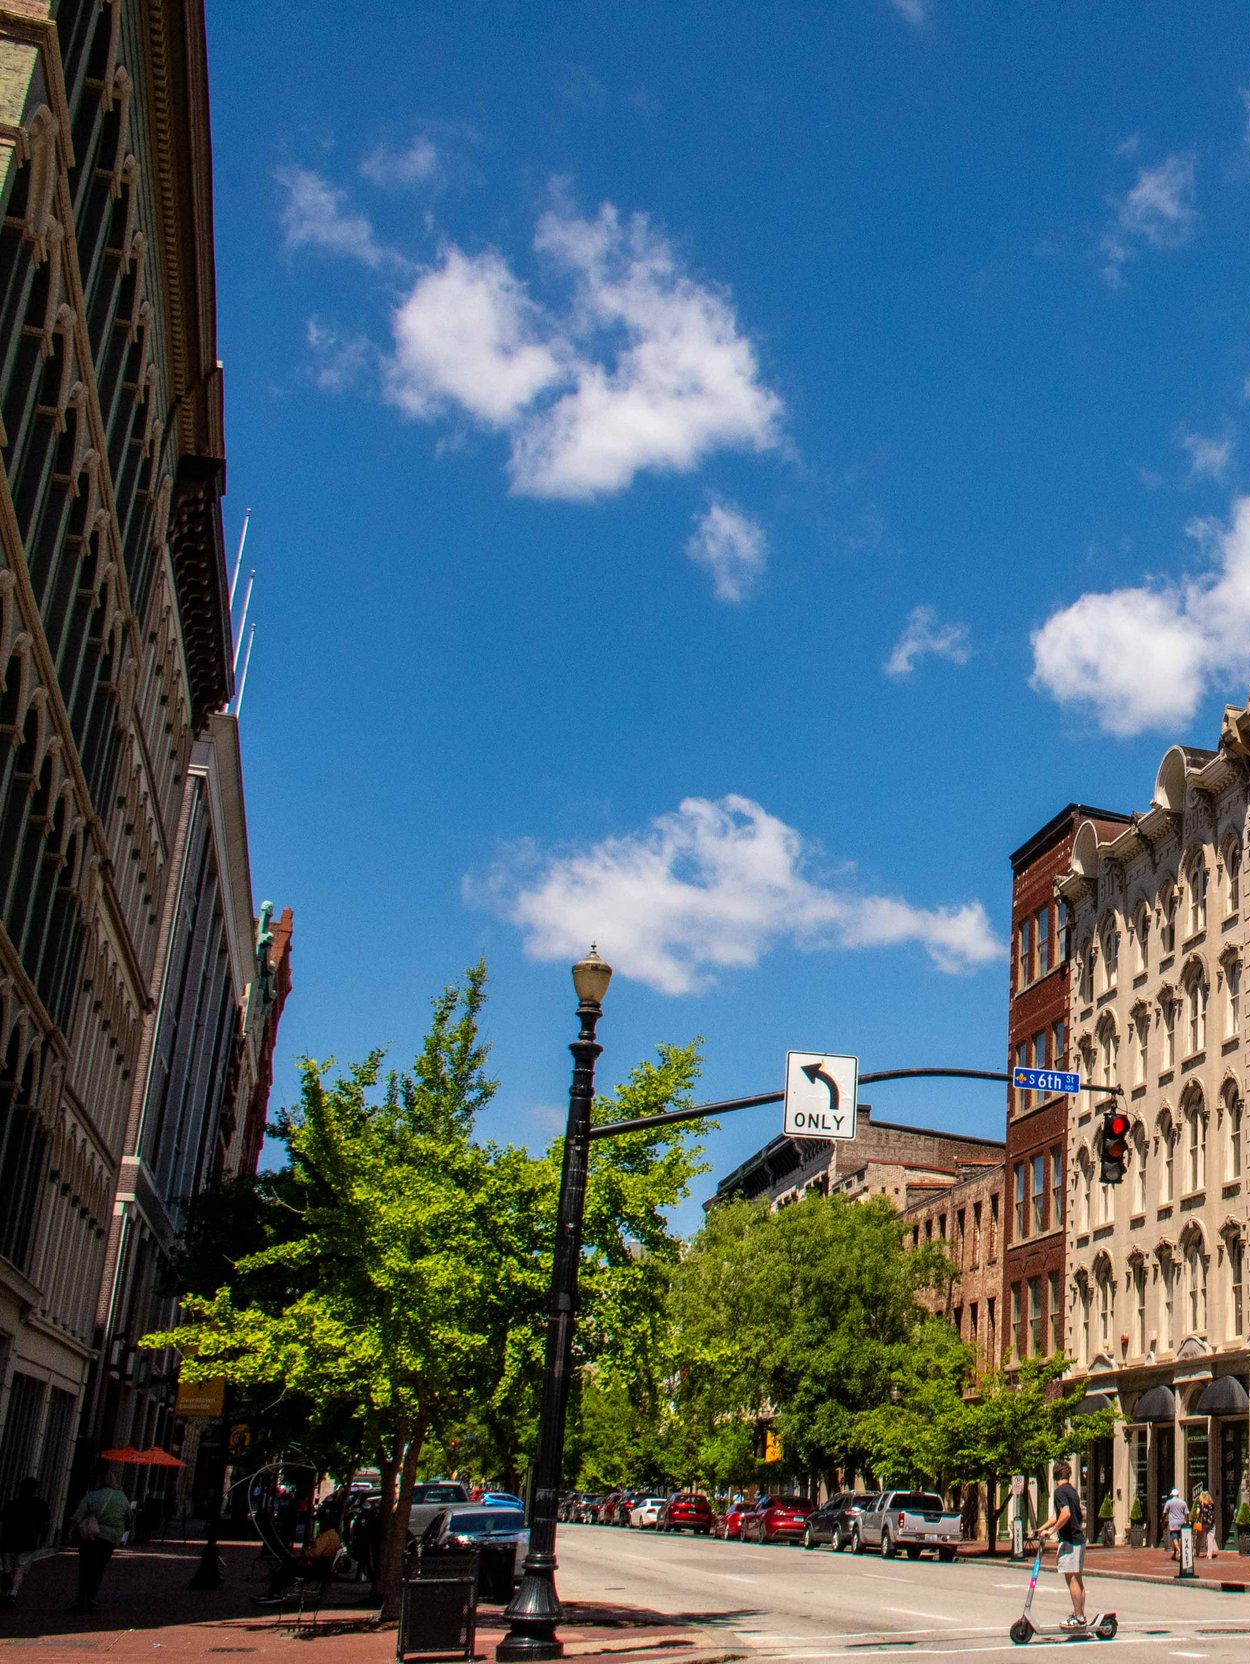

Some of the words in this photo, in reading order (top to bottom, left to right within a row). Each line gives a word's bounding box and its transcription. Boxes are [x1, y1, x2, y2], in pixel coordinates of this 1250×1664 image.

[1029, 1074, 1035, 1085] S
[1038, 1073, 1062, 1089] 6th
[1066, 1075, 1075, 1083] St
[794, 1111, 845, 1131] ONLY
